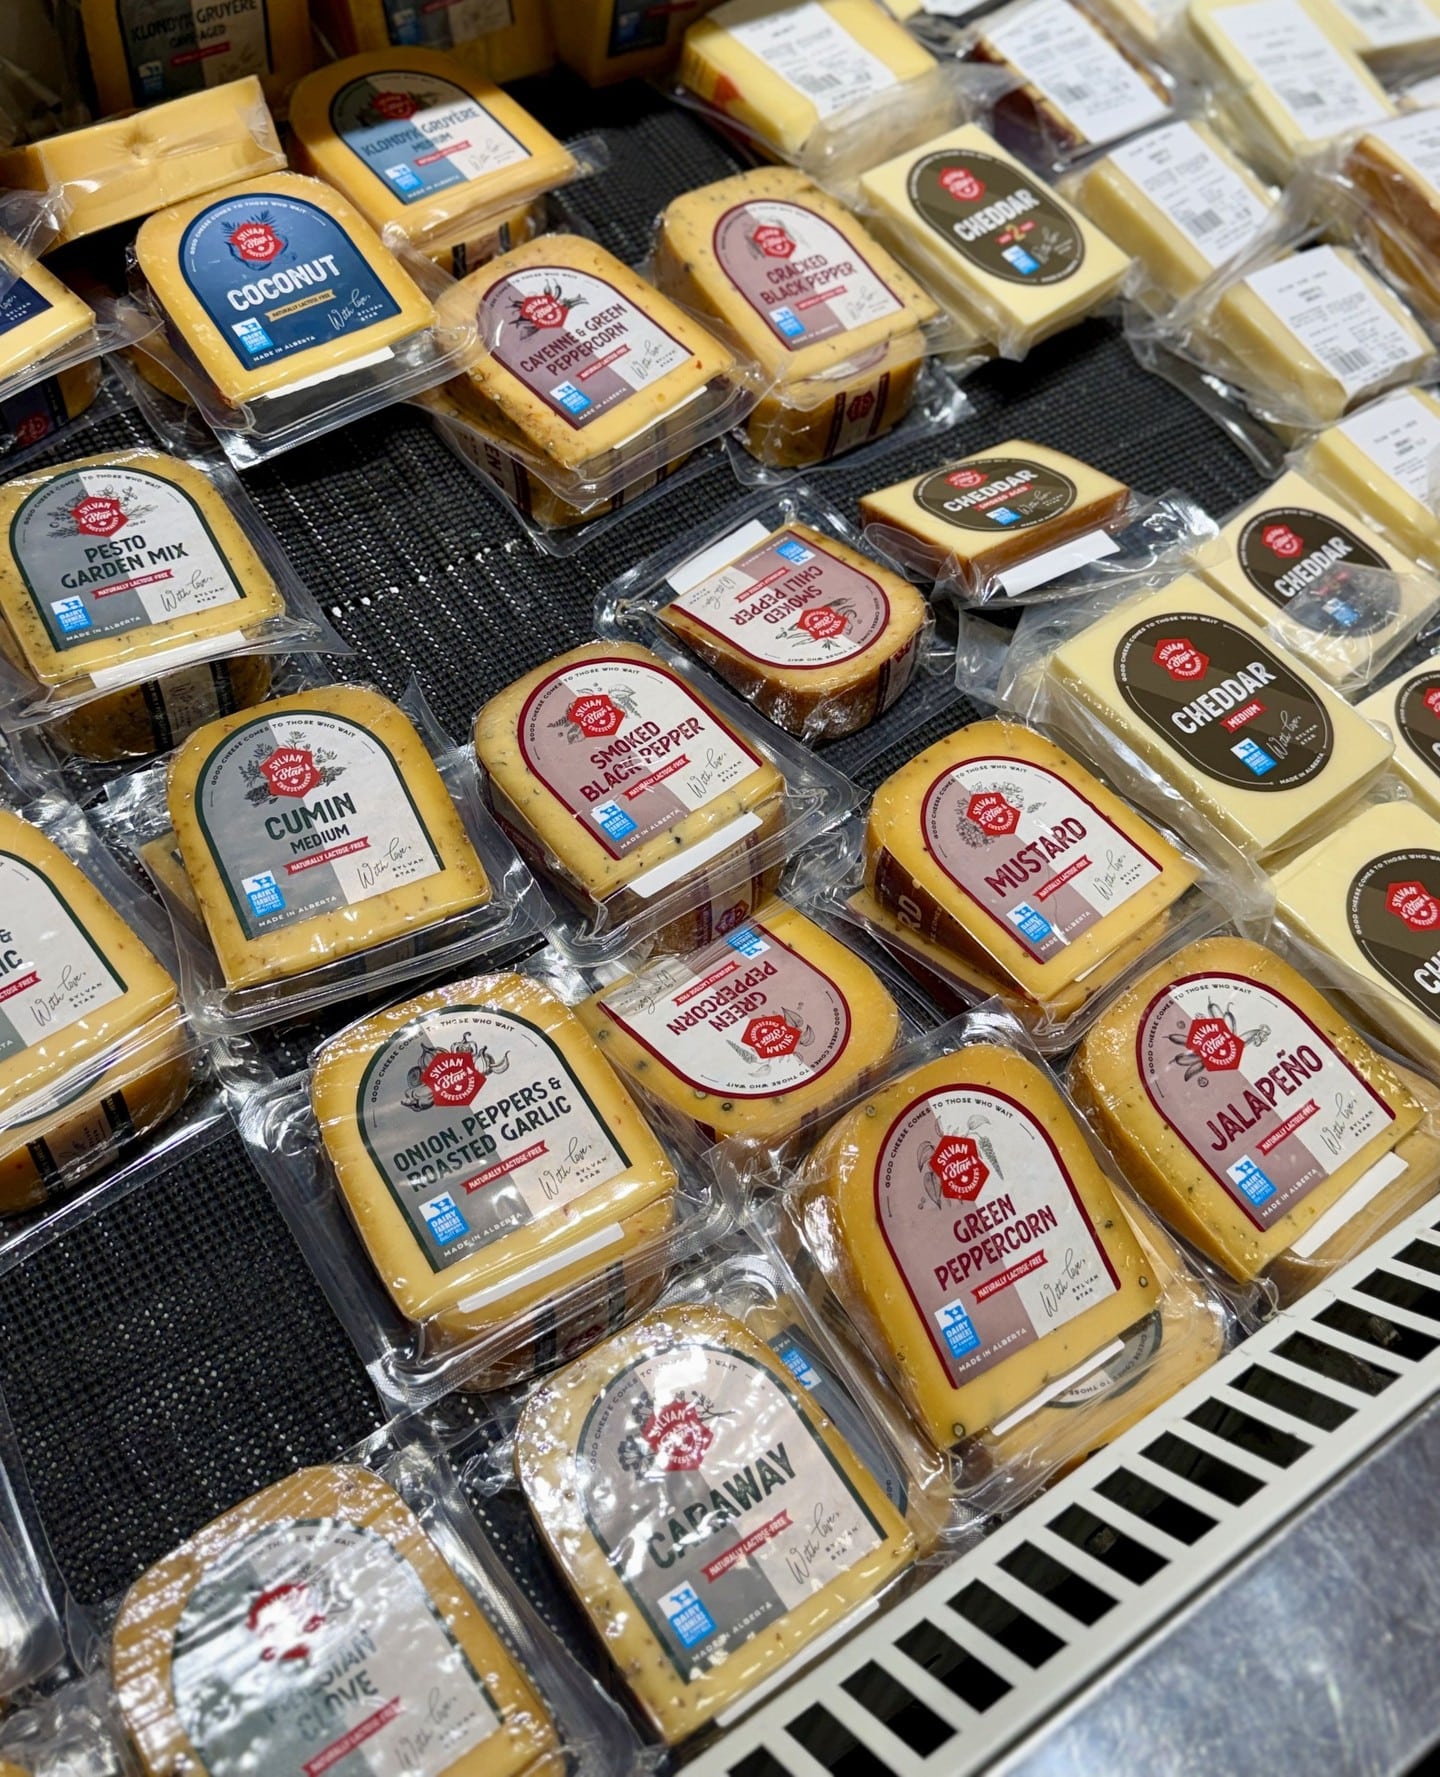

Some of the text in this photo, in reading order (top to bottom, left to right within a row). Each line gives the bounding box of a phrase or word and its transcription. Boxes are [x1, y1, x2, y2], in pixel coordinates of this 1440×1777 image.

[953, 188, 1040, 242] CHEDDAR
[226, 254, 341, 312] COCONUT
[760, 262, 857, 305] BLACK PEPPER
[766, 254, 828, 285] CRACKED
[272, 303, 298, 318] NATURALLY
[253, 351, 274, 362] MADE
[285, 335, 316, 350] ALBERTA
[519, 303, 628, 374] CAYENNE & GREEN
[546, 322, 629, 377] PEPPERCORN
[943, 469, 1039, 513] CHEDDAR
[79, 501, 111, 516] SYLVAN
[84, 534, 146, 563] PESTO
[60, 542, 189, 588] GARDEN MIX
[1274, 536, 1353, 598] CHEDDAR
[98, 572, 168, 597] NATURALLY LACTOSE FREE
[729, 565, 824, 626] CHILI PEPPER
[763, 585, 823, 624] SMOKED
[66, 631, 90, 641] MADE
[104, 616, 141, 632] ALBERTA
[1159, 642, 1184, 661] SYLVAN
[575, 700, 602, 718] SYLVAN
[1171, 661, 1277, 734] CHEDDAR
[1227, 703, 1261, 729] MEDIUM
[212, 765, 223, 786] GOOD
[221, 740, 243, 763] CHEESE
[243, 726, 270, 742] COMES
[317, 720, 336, 729] WHO
[338, 726, 356, 738] WAIT
[579, 717, 706, 802] BLACK PEPPER
[590, 720, 661, 770] SMOKED
[269, 754, 303, 771] SYLVAN
[276, 765, 304, 781] Star
[1279, 752, 1325, 785] MADE ALBERTA
[629, 778, 655, 797] NATURALLY
[264, 792, 357, 841] CUMIN
[972, 796, 997, 815] SYLVAN
[290, 824, 351, 855] MEDIUM
[620, 808, 681, 850] MADE ALBERTA
[291, 841, 365, 872] NATURALLY LACTOSE-FREE
[391, 857, 425, 872] SYLVAN
[983, 817, 1088, 898] MUSTARD
[395, 868, 417, 878] STAR
[1039, 878, 1062, 898] NATURALLY
[251, 888, 276, 901] DAIRY
[259, 915, 284, 927] MADE
[298, 895, 337, 913] ALBERTA
[707, 965, 734, 986] NATURALLY
[665, 960, 779, 1036] PEPPERCORN
[708, 991, 768, 1033] GREEN
[1149, 1021, 1159, 1049] CHEESE
[1156, 1000, 1174, 1020] COMES
[1175, 992, 1185, 1000] TO
[1185, 984, 1209, 994] THOSE
[1232, 986, 1252, 995] WAIT
[766, 1033, 794, 1054] SYLVAN
[1192, 1023, 1220, 1046] SYLVAN
[429, 1057, 464, 1079] SYLVAN
[439, 1069, 467, 1089] Star
[462, 1081, 548, 1136] PEPPERS
[548, 1077, 563, 1090] &
[1206, 1044, 1323, 1151] JALAPEÑO
[1349, 1110, 1373, 1131] SYLVAN
[406, 1095, 572, 1192] ROASTED GARLIC
[884, 1161, 894, 1189] GOOD
[890, 1129, 909, 1159] CHEESE
[907, 1107, 932, 1129] COMES
[945, 1097, 972, 1106] THOSE
[974, 1098, 994, 1109] WHO
[995, 1105, 1015, 1119] WAIT
[1262, 1126, 1288, 1151] NATURALLY
[468, 1146, 544, 1189] NATURALLY LACTOSE-FREE
[575, 1155, 608, 1177] SYLVAN
[936, 1143, 969, 1166] SYLVAN
[944, 1158, 971, 1178] Star
[1261, 1168, 1317, 1218] MADE IN ALBERTA
[430, 1211, 457, 1227] DAIRY
[953, 1193, 1017, 1244] GREEN
[934, 1204, 1059, 1292] PEPPERCORN
[977, 1256, 1044, 1298] NATURALLY LACTOSE-FREE
[1071, 1274, 1100, 1294] SYLVAN
[1076, 1287, 1094, 1301] STAR
[945, 1321, 969, 1338] DAIRY
[958, 1327, 1028, 1373] MADE IN ALBERTA
[708, 1516, 787, 1576] NATURALLY LACTOSE-FREE
[732, 1602, 773, 1634] ALBERTA
